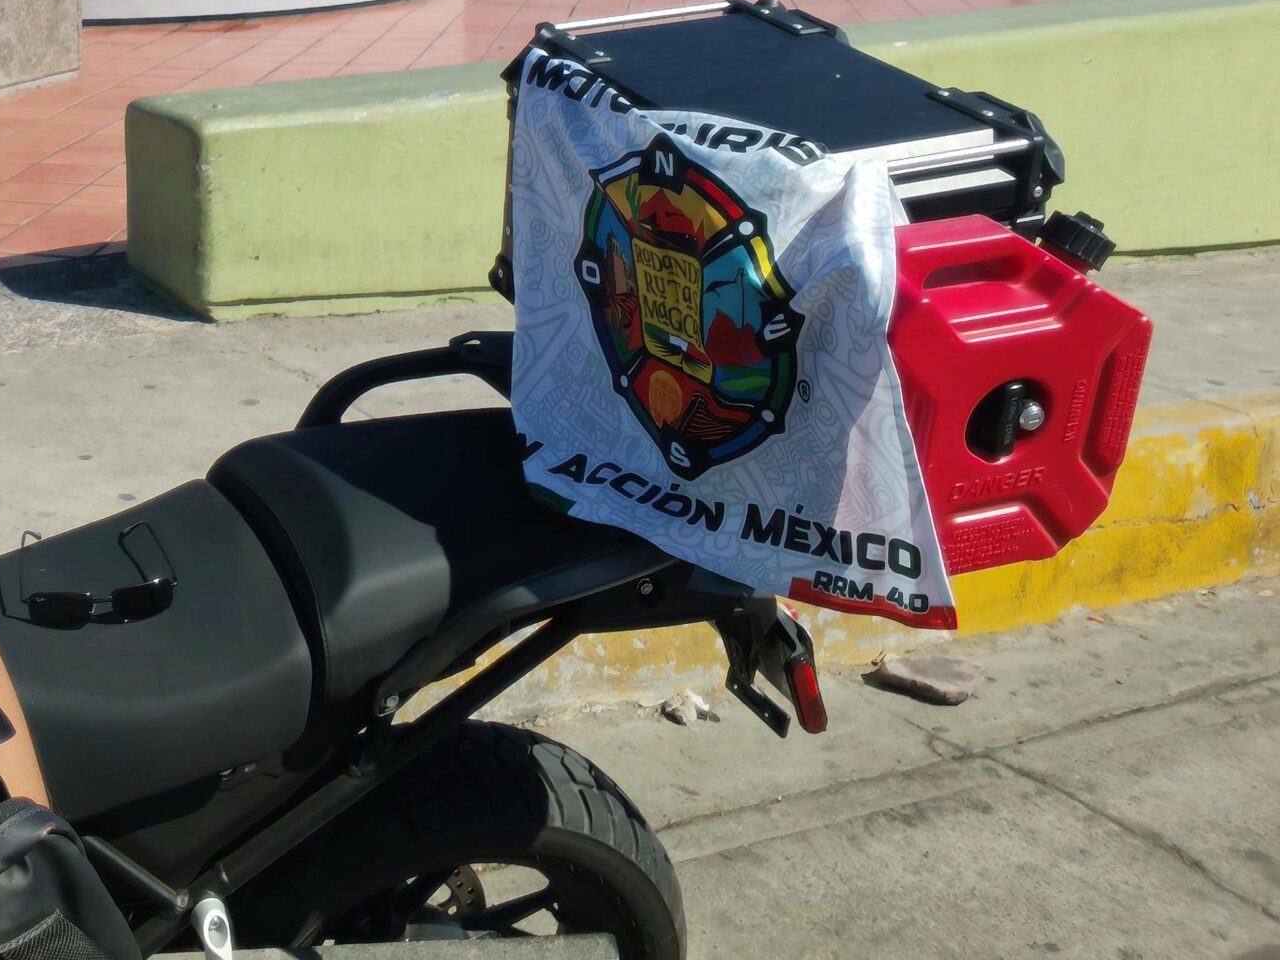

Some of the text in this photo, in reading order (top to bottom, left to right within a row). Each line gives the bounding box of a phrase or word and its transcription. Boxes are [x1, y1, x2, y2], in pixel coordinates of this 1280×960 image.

[654, 149, 674, 177] N
[581, 259, 601, 285] O
[763, 313, 791, 341] E
[670, 441, 692, 468] S
[947, 465, 1048, 504] DANGER
[547, 452, 725, 532] ACCIÓN
[740, 503, 922, 580] MÉXICO
[811, 570, 930, 615] RRM 4.0
